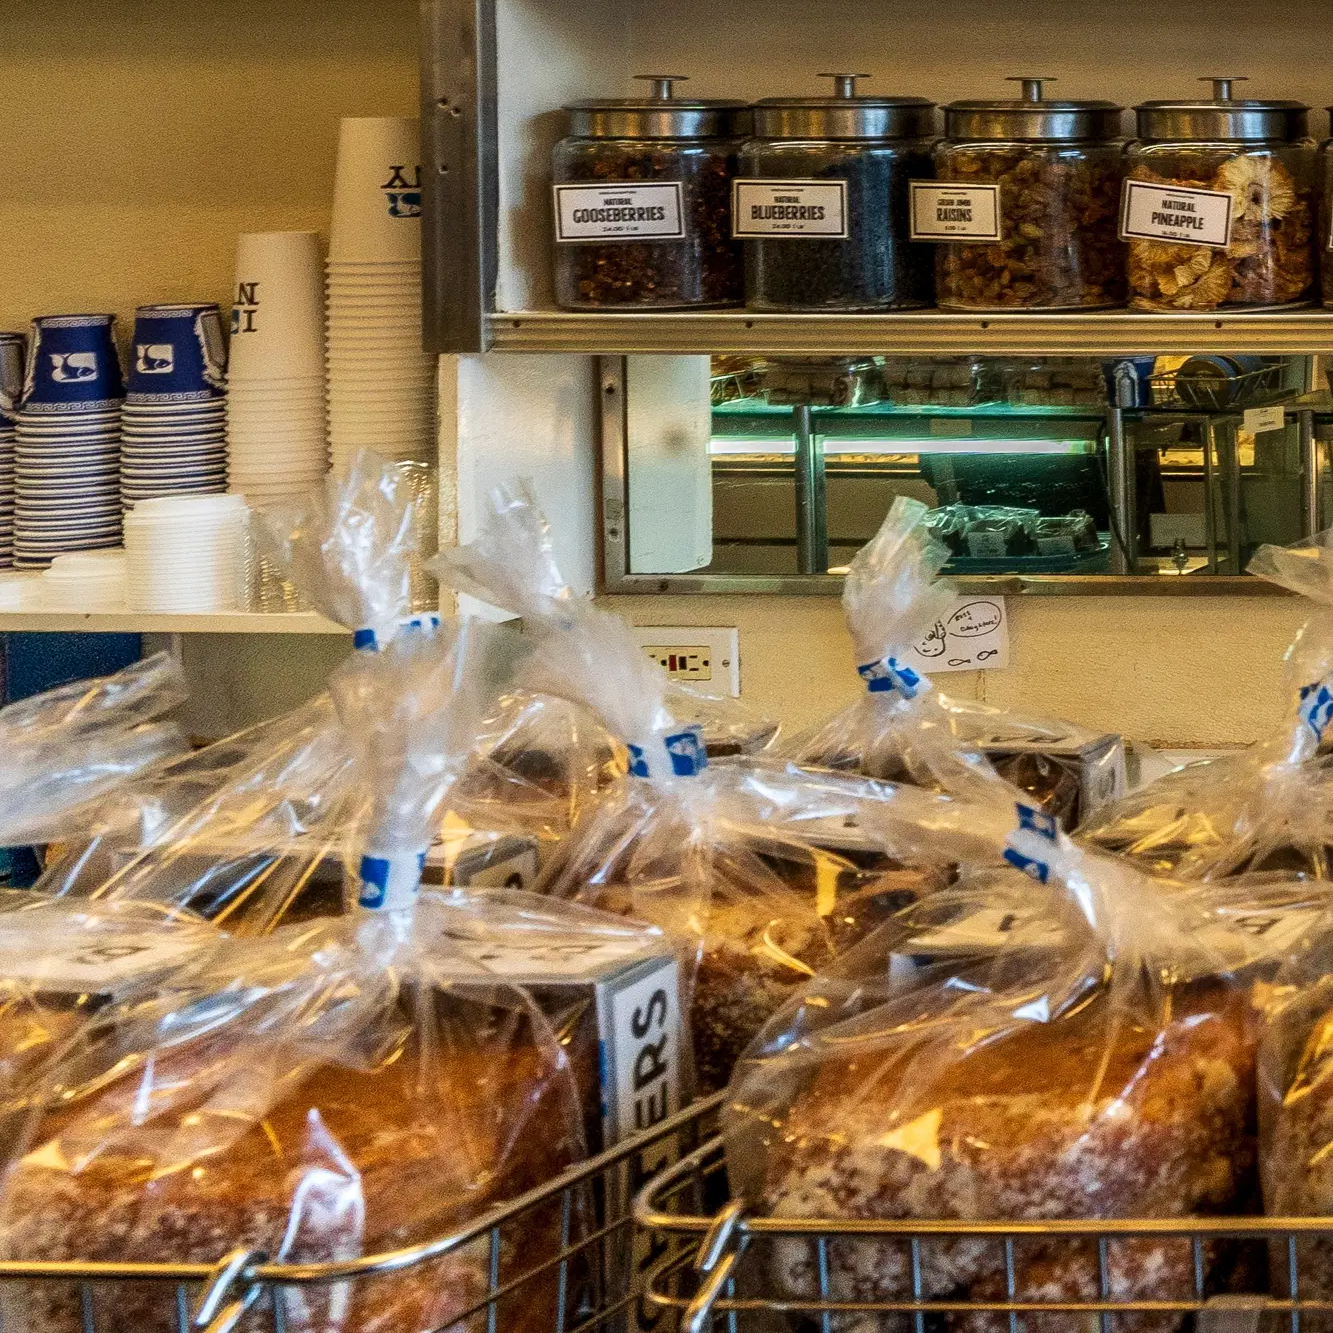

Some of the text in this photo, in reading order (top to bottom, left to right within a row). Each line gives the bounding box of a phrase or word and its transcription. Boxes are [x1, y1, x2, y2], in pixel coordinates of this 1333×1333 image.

[751, 205, 826, 220] BLUEBERRIES
[1161, 199, 1196, 213] NATURAL
[572, 206, 665, 224] GOOSEBERRIES
[936, 207, 972, 222] RAISINS
[1151, 211, 1205, 230] PINEAPPLE
